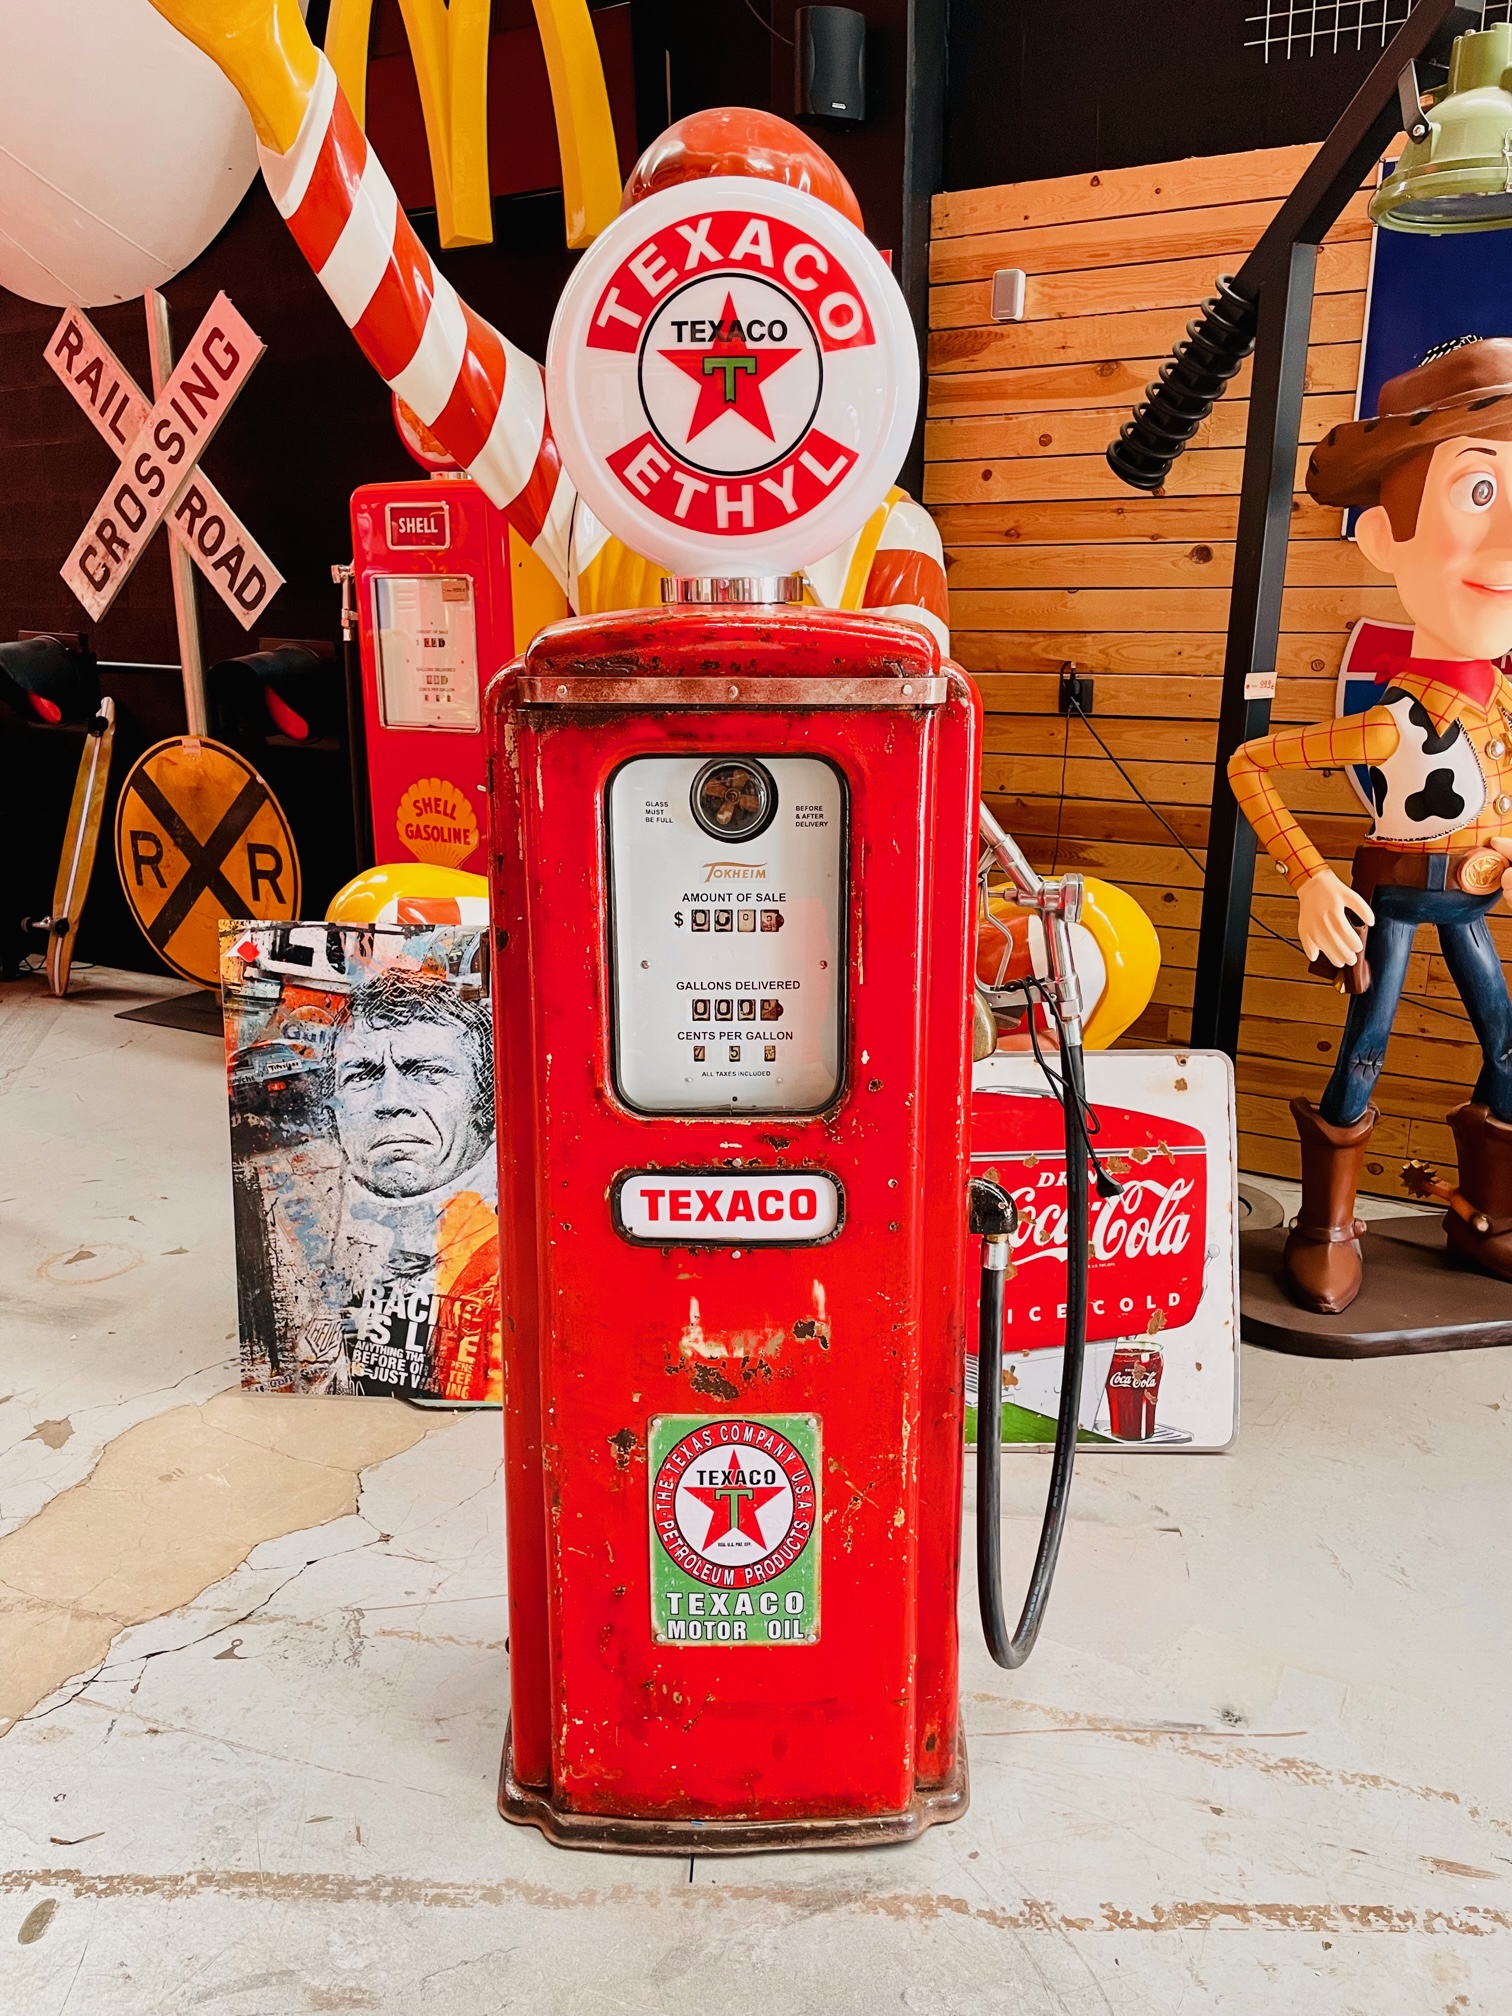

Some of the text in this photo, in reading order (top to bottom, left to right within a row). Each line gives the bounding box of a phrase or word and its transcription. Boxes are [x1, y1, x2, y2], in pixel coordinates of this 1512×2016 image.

[596, 217, 863, 341] TEXACO
[671, 319, 788, 343] TEXACO
[54, 320, 130, 445] RAIL
[702, 356, 757, 405] T
[78, 327, 240, 592] CROSSING
[623, 442, 849, 528] ETHYL
[398, 517, 438, 534] SHELL
[174, 484, 268, 611] ROAD
[412, 797, 457, 821] SHELL
[404, 823, 472, 846] GASOLINE
[129, 830, 287, 905] R R
[681, 893, 787, 902] AMOUNT OF SALE
[674, 911, 684, 928] $
[676, 980, 800, 991] GALLONS DELIVERED
[677, 1031, 793, 1040] CENTS PER GALLON
[639, 1188, 817, 1222] TEXACO
[1007, 1292, 1182, 1324] ICE COLD
[352, 1350, 406, 1372] BEFORE
[355, 1340, 404, 1359] ANYTHING
[370, 1364, 409, 1387] JUST
[656, 1478, 674, 1511] THE
[665, 1430, 713, 1475] TEXAS
[719, 1424, 797, 1466] COMPANY
[696, 1469, 776, 1486] TEXACO
[714, 1488, 754, 1531] T
[658, 1518, 811, 1586] PETROLEUM PRODUCTS
[666, 1591, 805, 1616] TEXACO
[666, 1619, 806, 1640] MOTOR OIL
